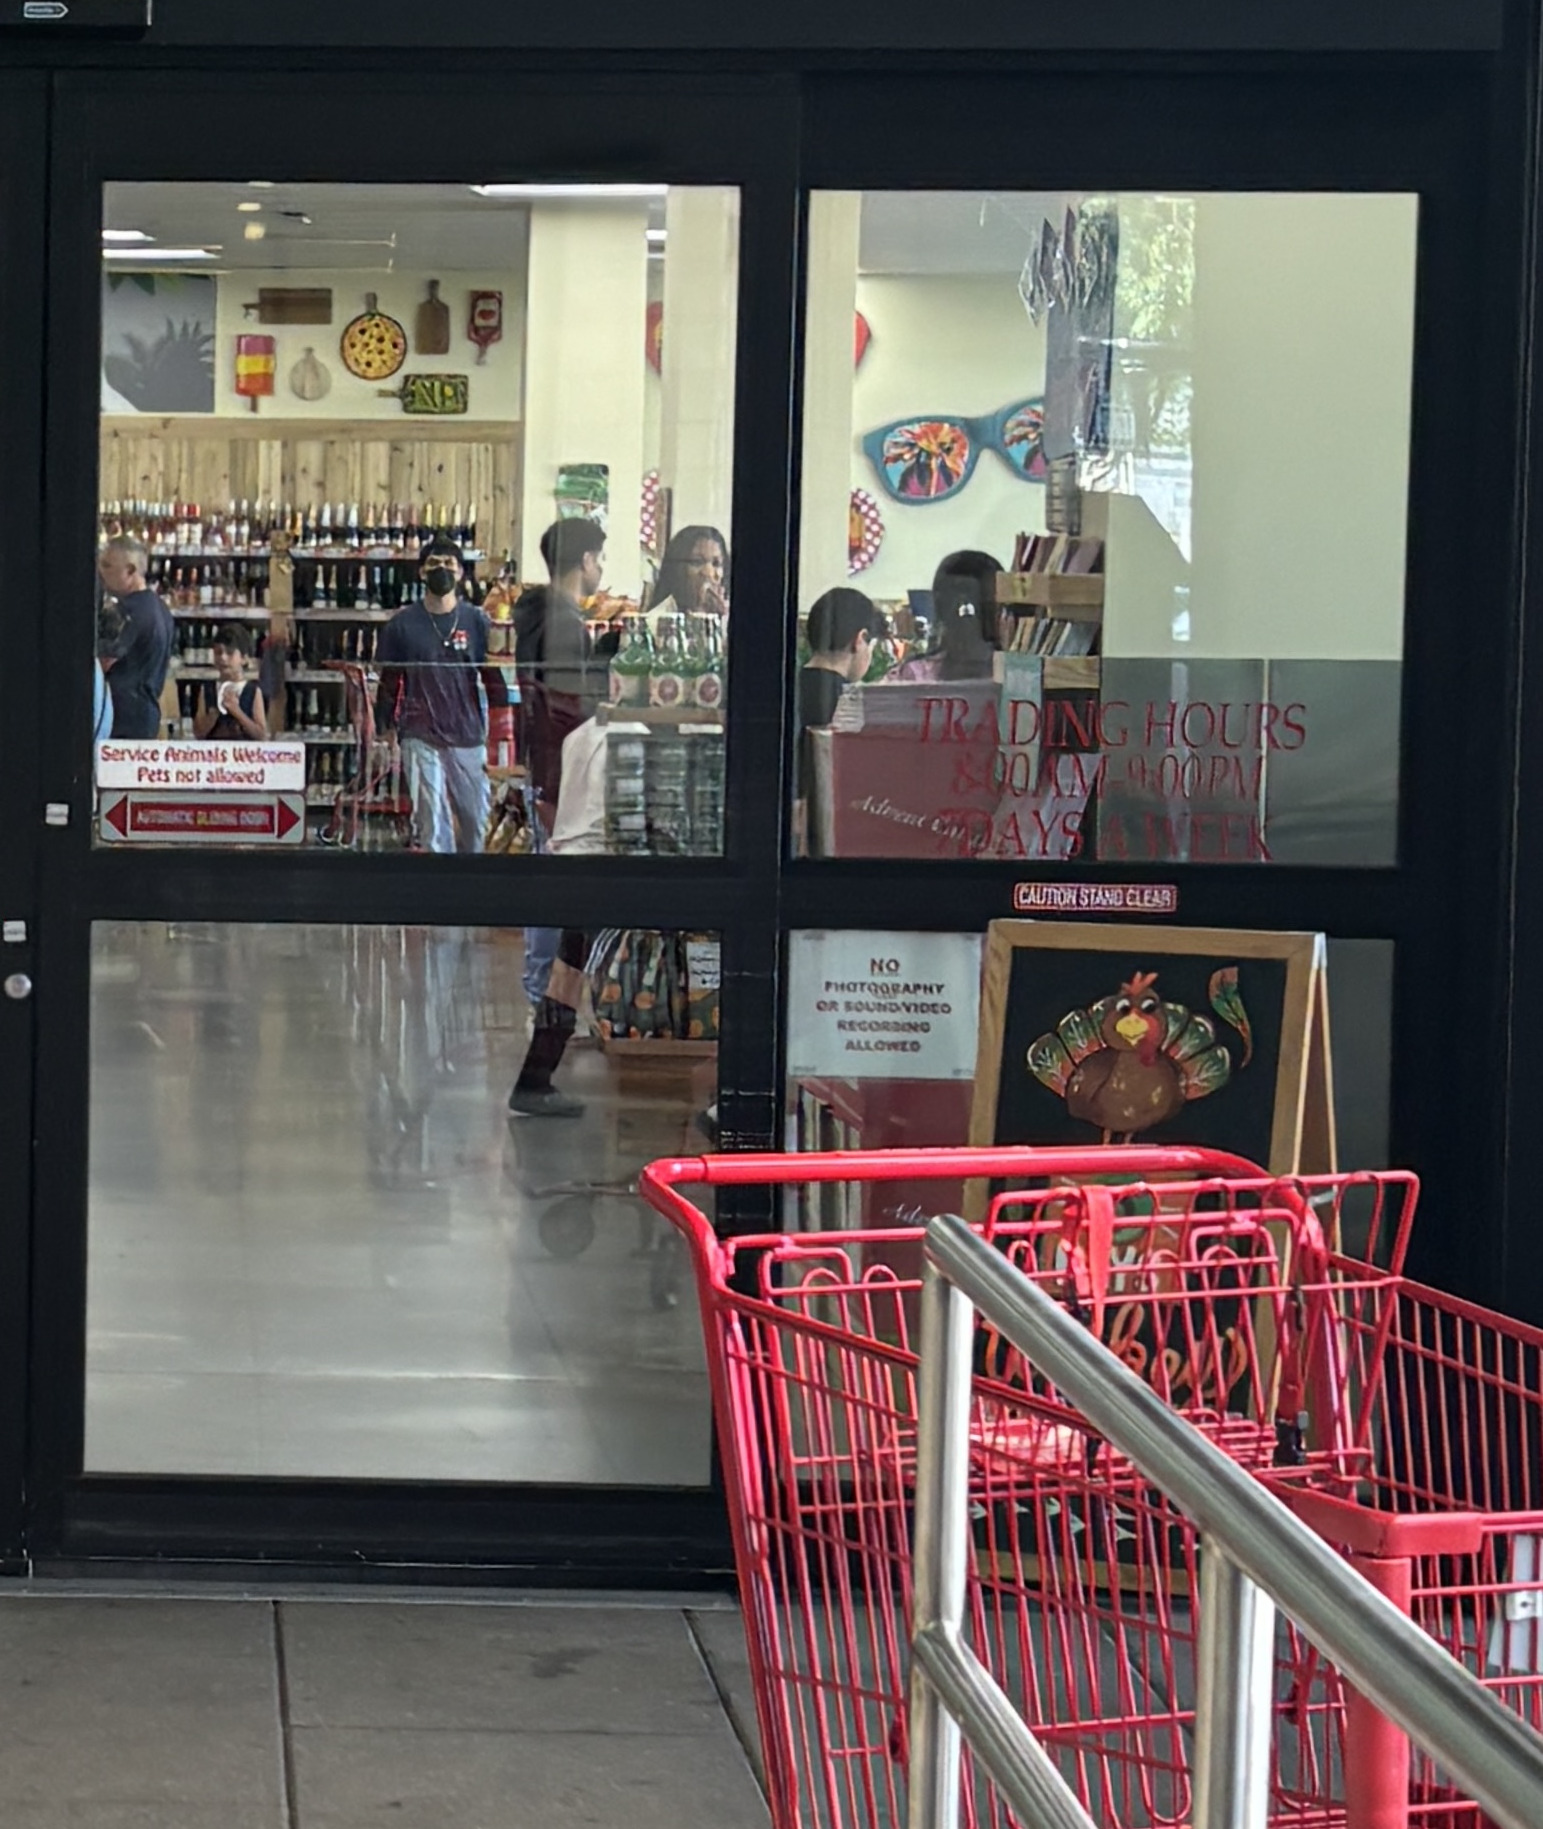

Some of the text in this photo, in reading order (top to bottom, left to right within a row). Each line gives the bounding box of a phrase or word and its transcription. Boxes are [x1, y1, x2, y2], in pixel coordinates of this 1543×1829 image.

[915, 697, 1307, 751] TRADING HOURS
[100, 745, 301, 764] Service Animals Welcome
[137, 766, 265, 784] Pets not allowed
[962, 809, 1084, 859] DAYS
[1097, 814, 1129, 861] A
[1144, 811, 1274, 862] WEEK
[1019, 885, 1172, 908] CAUTION STAND CLEAR
[870, 957, 901, 974] NO
[824, 980, 946, 995] PHOTOGRAPHY
[815, 1000, 952, 1014] OR SOUND/VIDEO
[837, 1019, 931, 1034] RECORDING
[845, 1039, 922, 1053] ALLOWED
